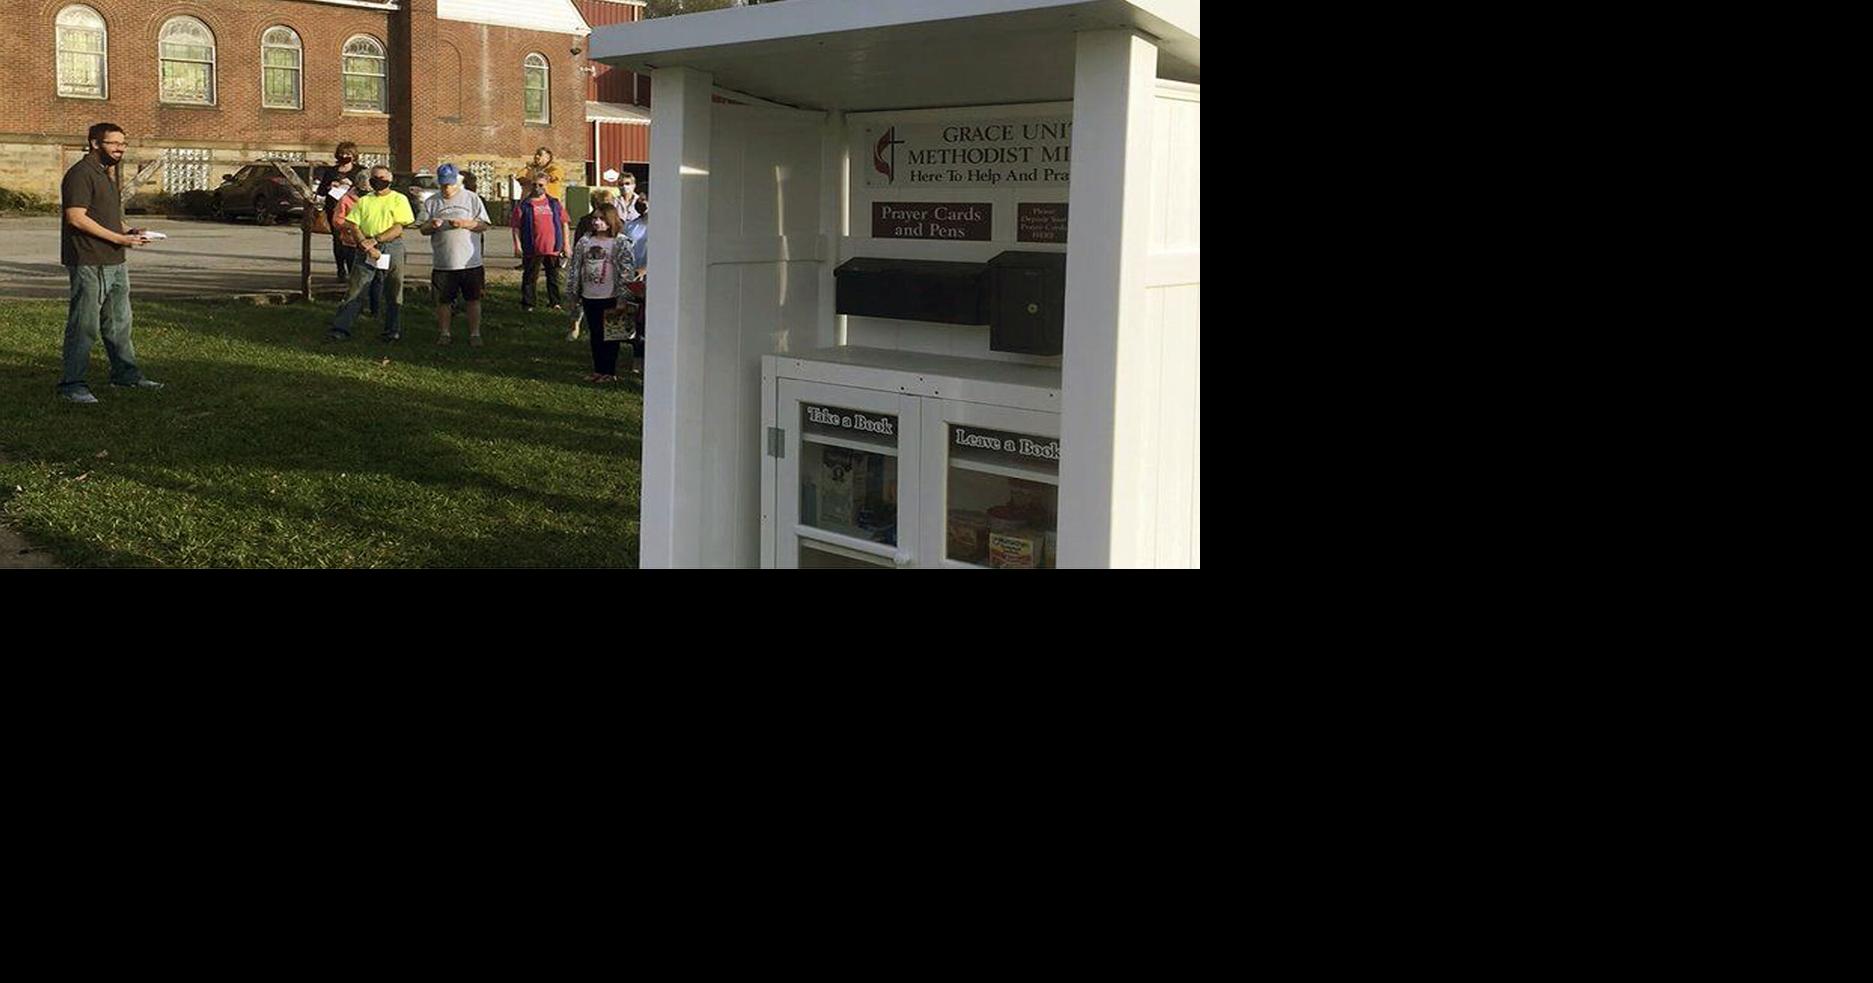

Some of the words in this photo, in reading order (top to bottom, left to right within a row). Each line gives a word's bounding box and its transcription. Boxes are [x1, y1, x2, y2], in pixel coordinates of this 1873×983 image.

[942, 124, 1014, 143] GRACE
[1023, 121, 1072, 140] UNI
[908, 147, 1033, 165] METHODIST
[910, 171, 943, 182] Here
[947, 170, 963, 182] To
[968, 169, 1001, 185] Help
[1006, 169, 1037, 182] And
[881, 206, 928, 223] Prayer
[934, 207, 981, 221] Cards
[895, 224, 923, 237] and
[929, 224, 965, 238] Pens
[807, 406, 840, 426] Take
[842, 416, 851, 428] a
[854, 415, 893, 434] Book
[956, 429, 1000, 450] Leave
[1003, 440, 1016, 452] a
[1019, 439, 1060, 460] Book
